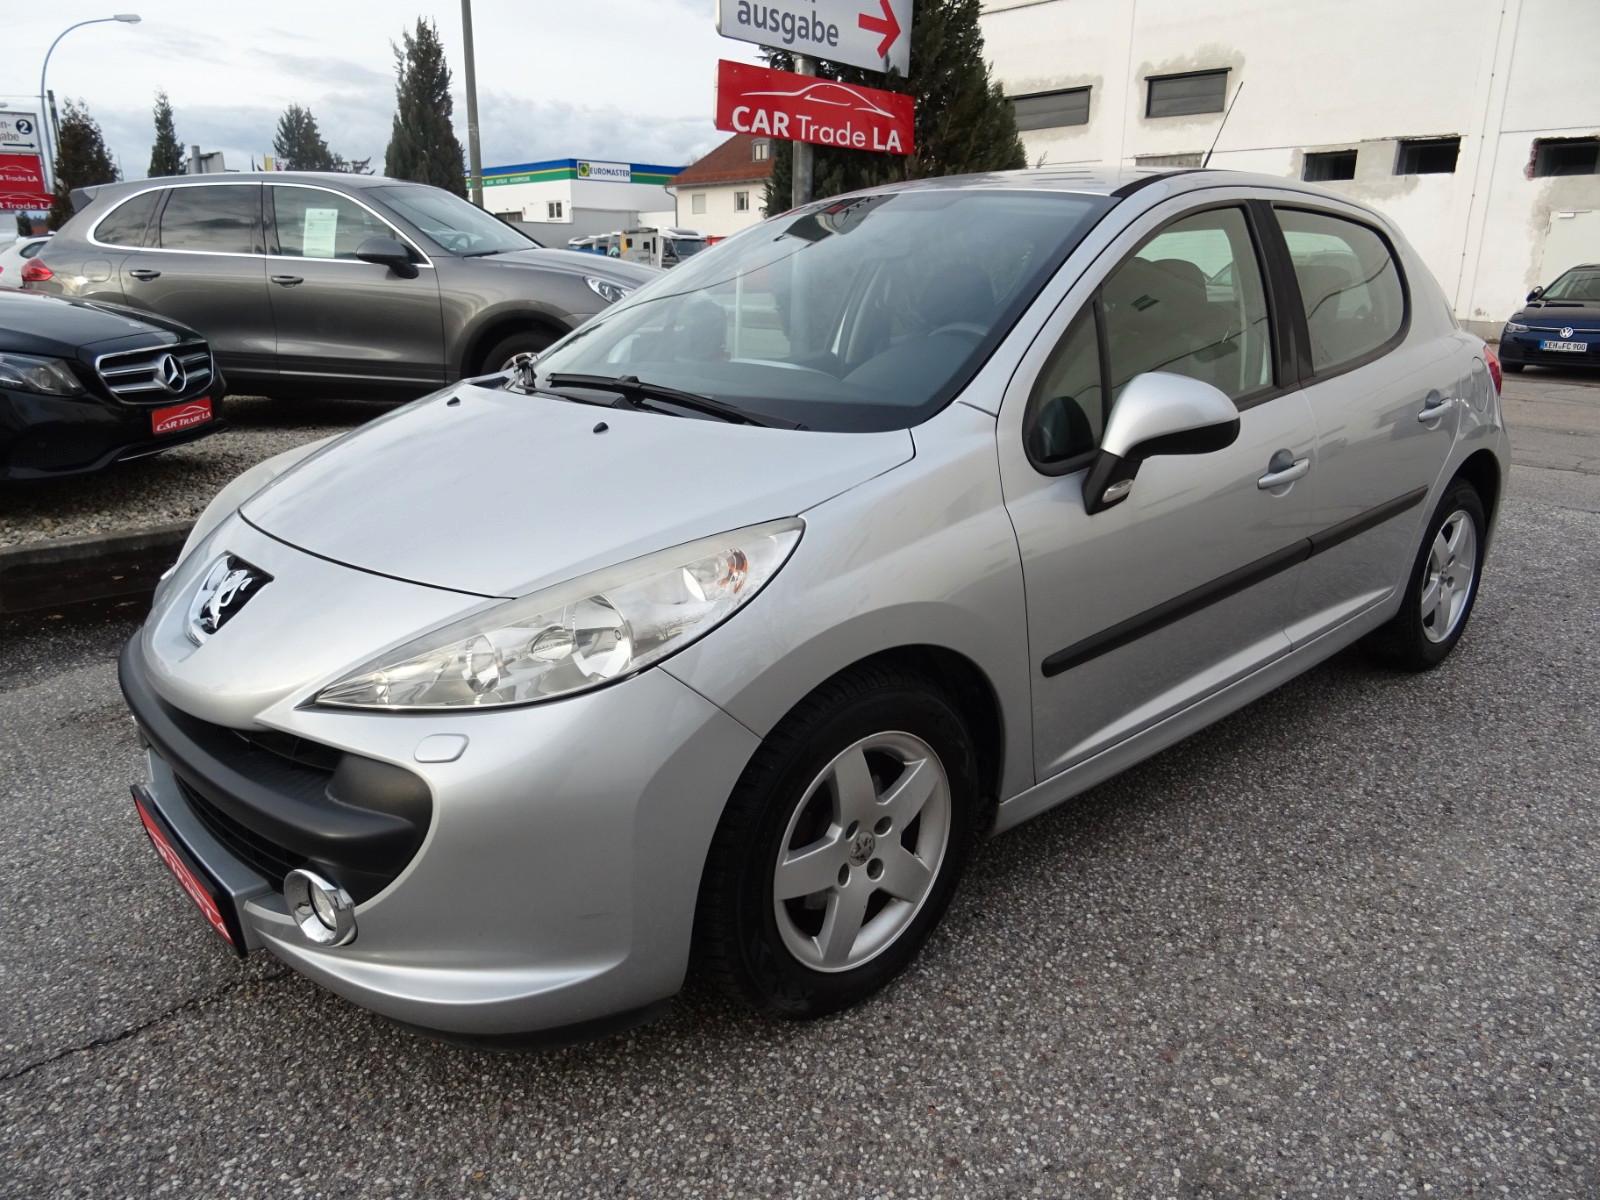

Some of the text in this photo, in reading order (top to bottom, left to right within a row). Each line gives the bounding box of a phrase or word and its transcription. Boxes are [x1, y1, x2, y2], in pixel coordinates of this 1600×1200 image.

[737, 0, 839, 47] ausgabe
[731, 106, 902, 153] CAR Trade LA
[589, 167, 630, 177] EUROMASTER
[5, 201, 38, 209] Trade
[1562, 342, 1572, 350] FC
[1572, 343, 1586, 351] 900
[156, 420, 177, 432] CAR
[201, 411, 211, 419] LA
